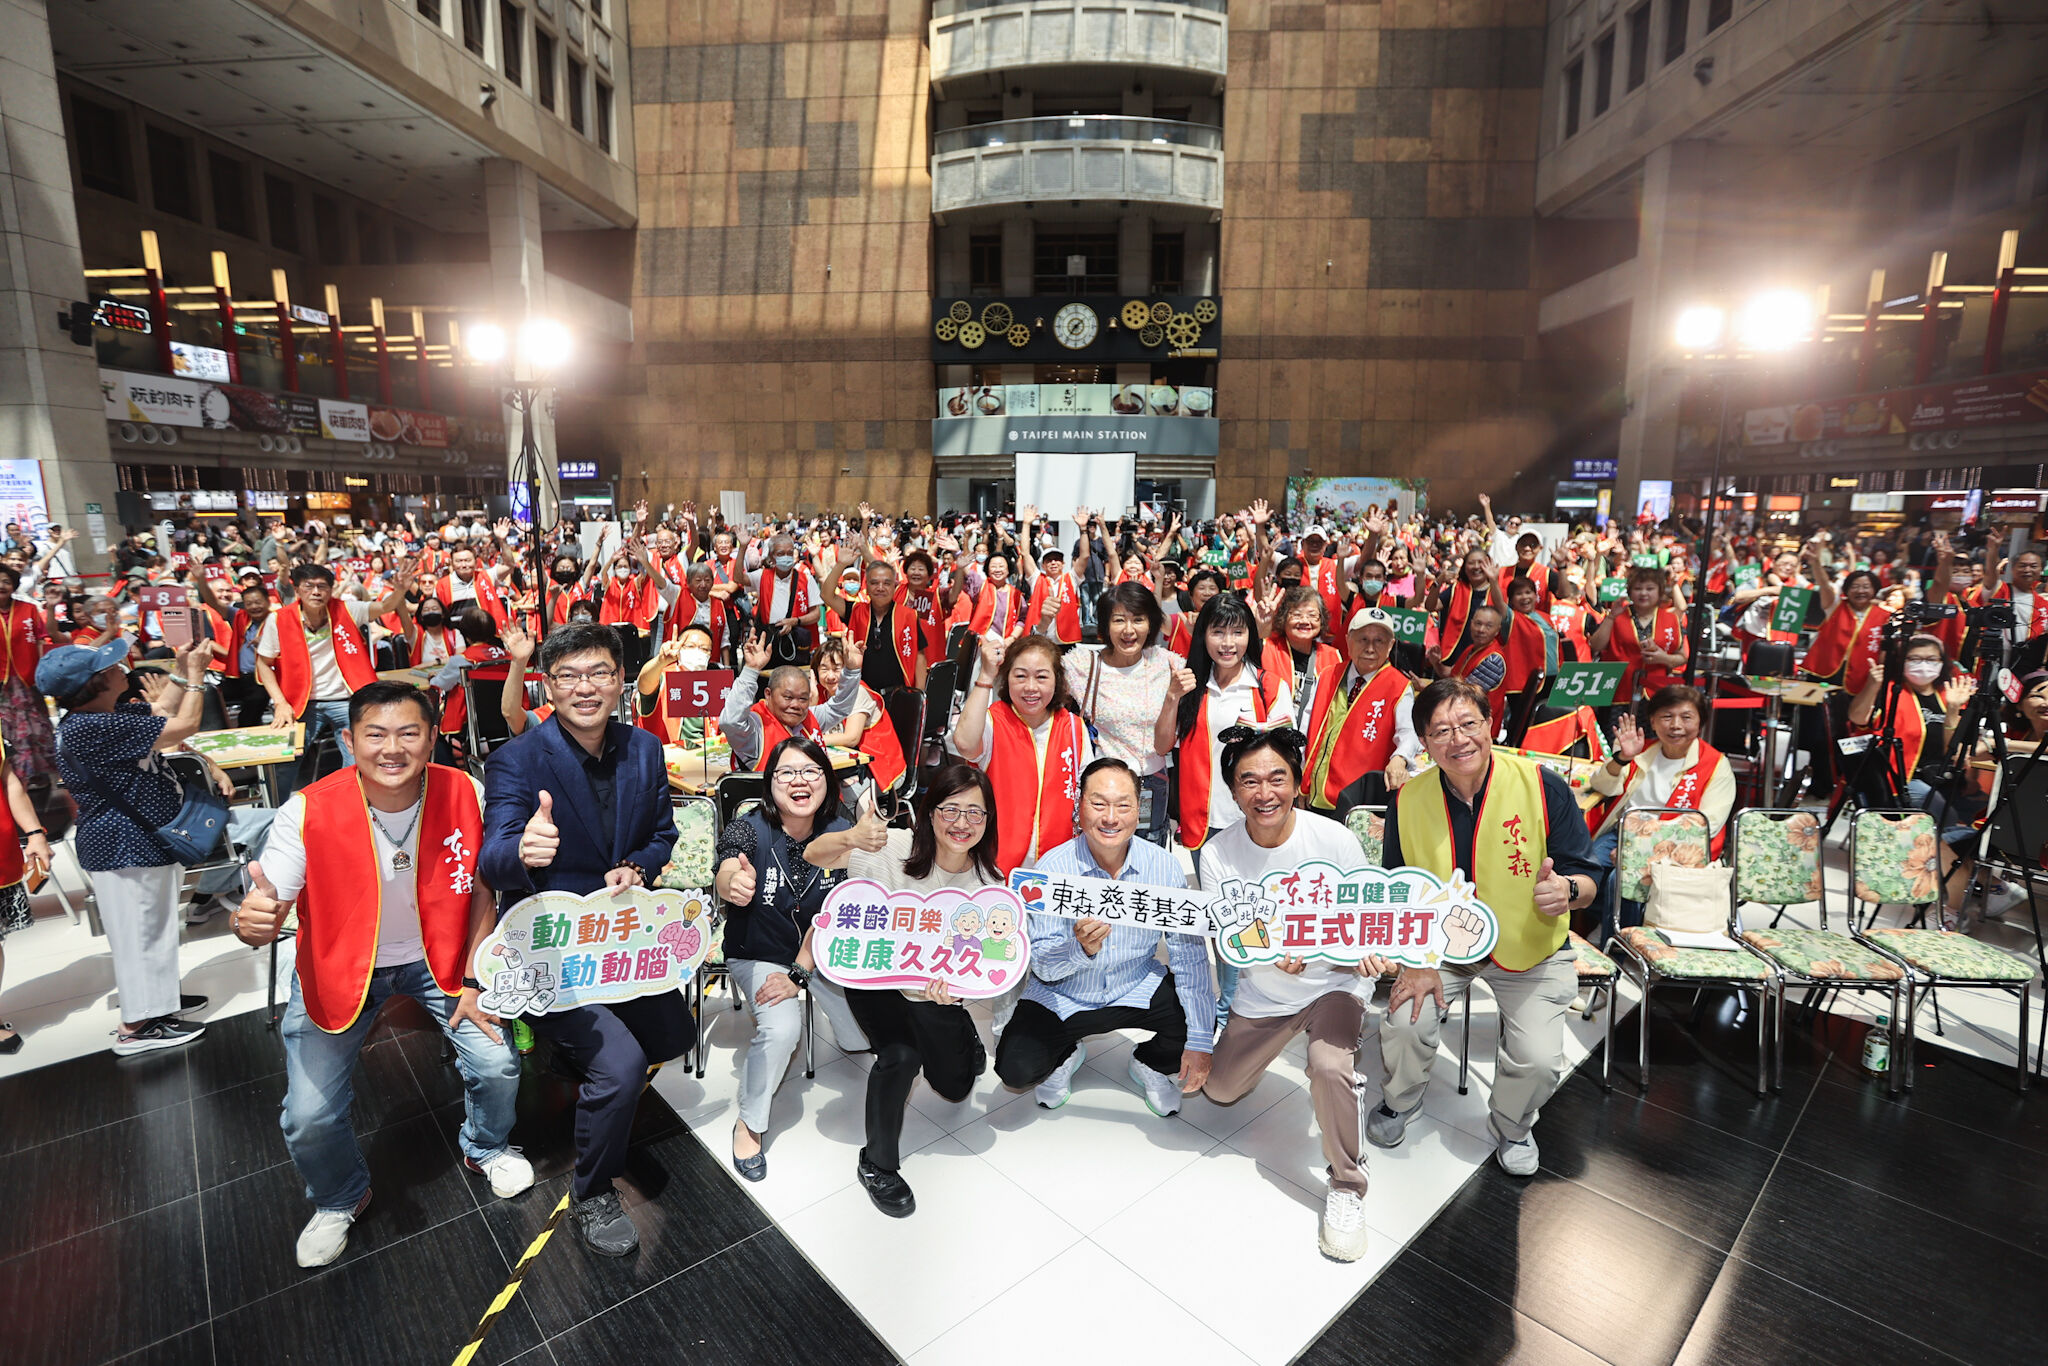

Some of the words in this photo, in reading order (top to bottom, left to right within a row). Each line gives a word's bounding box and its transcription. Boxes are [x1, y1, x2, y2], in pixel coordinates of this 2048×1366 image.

[1022, 431, 1058, 440] TAIPEI
[1063, 431, 1094, 439] MAIN
[1098, 430, 1147, 440] STATION
[156, 592, 170, 606] 8
[488, 645, 505, 658] 34
[692, 681, 709, 707] 5
[1555, 672, 1618, 697] 第51桌
[762, 867, 777, 907] 姚淑文
[836, 903, 942, 933] 樂齡同樂
[1282, 912, 1434, 947] 正式開打
[560, 947, 671, 990] 動動腦
[828, 937, 983, 977] 健康久久久
